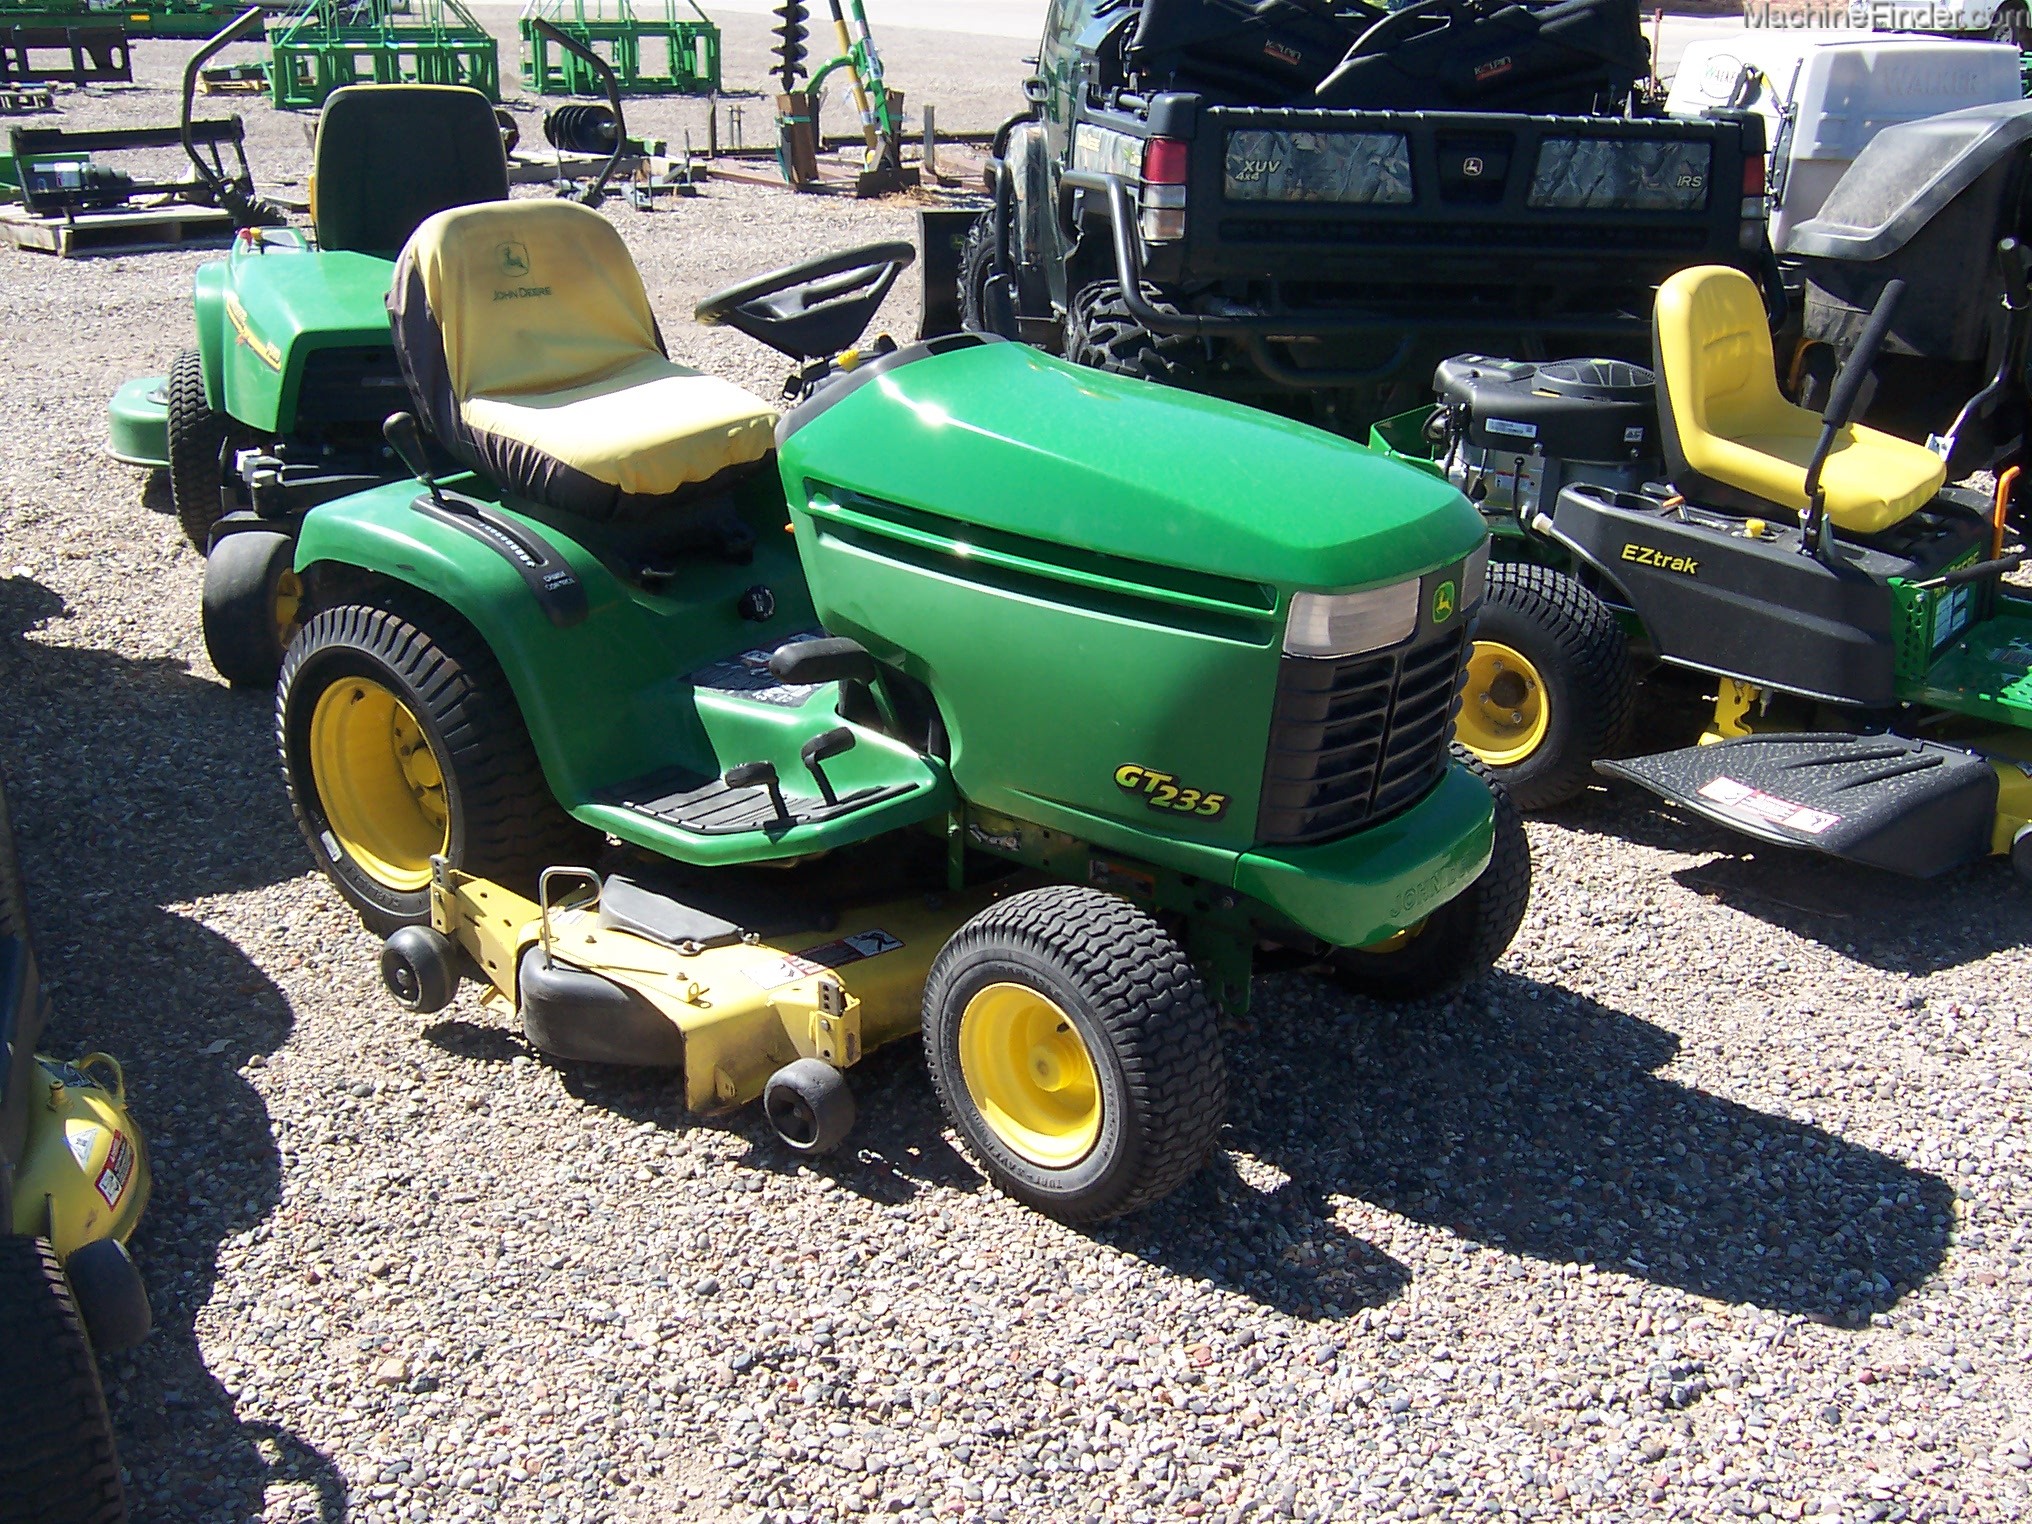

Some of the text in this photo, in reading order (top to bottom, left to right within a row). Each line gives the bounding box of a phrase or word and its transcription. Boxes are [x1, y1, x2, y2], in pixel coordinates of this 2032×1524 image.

[1242, 159, 1281, 174] XUV
[1234, 171, 1260, 182] 4x4
[1676, 174, 1703, 188] IRS
[1620, 543, 1699, 575] EZtrak
